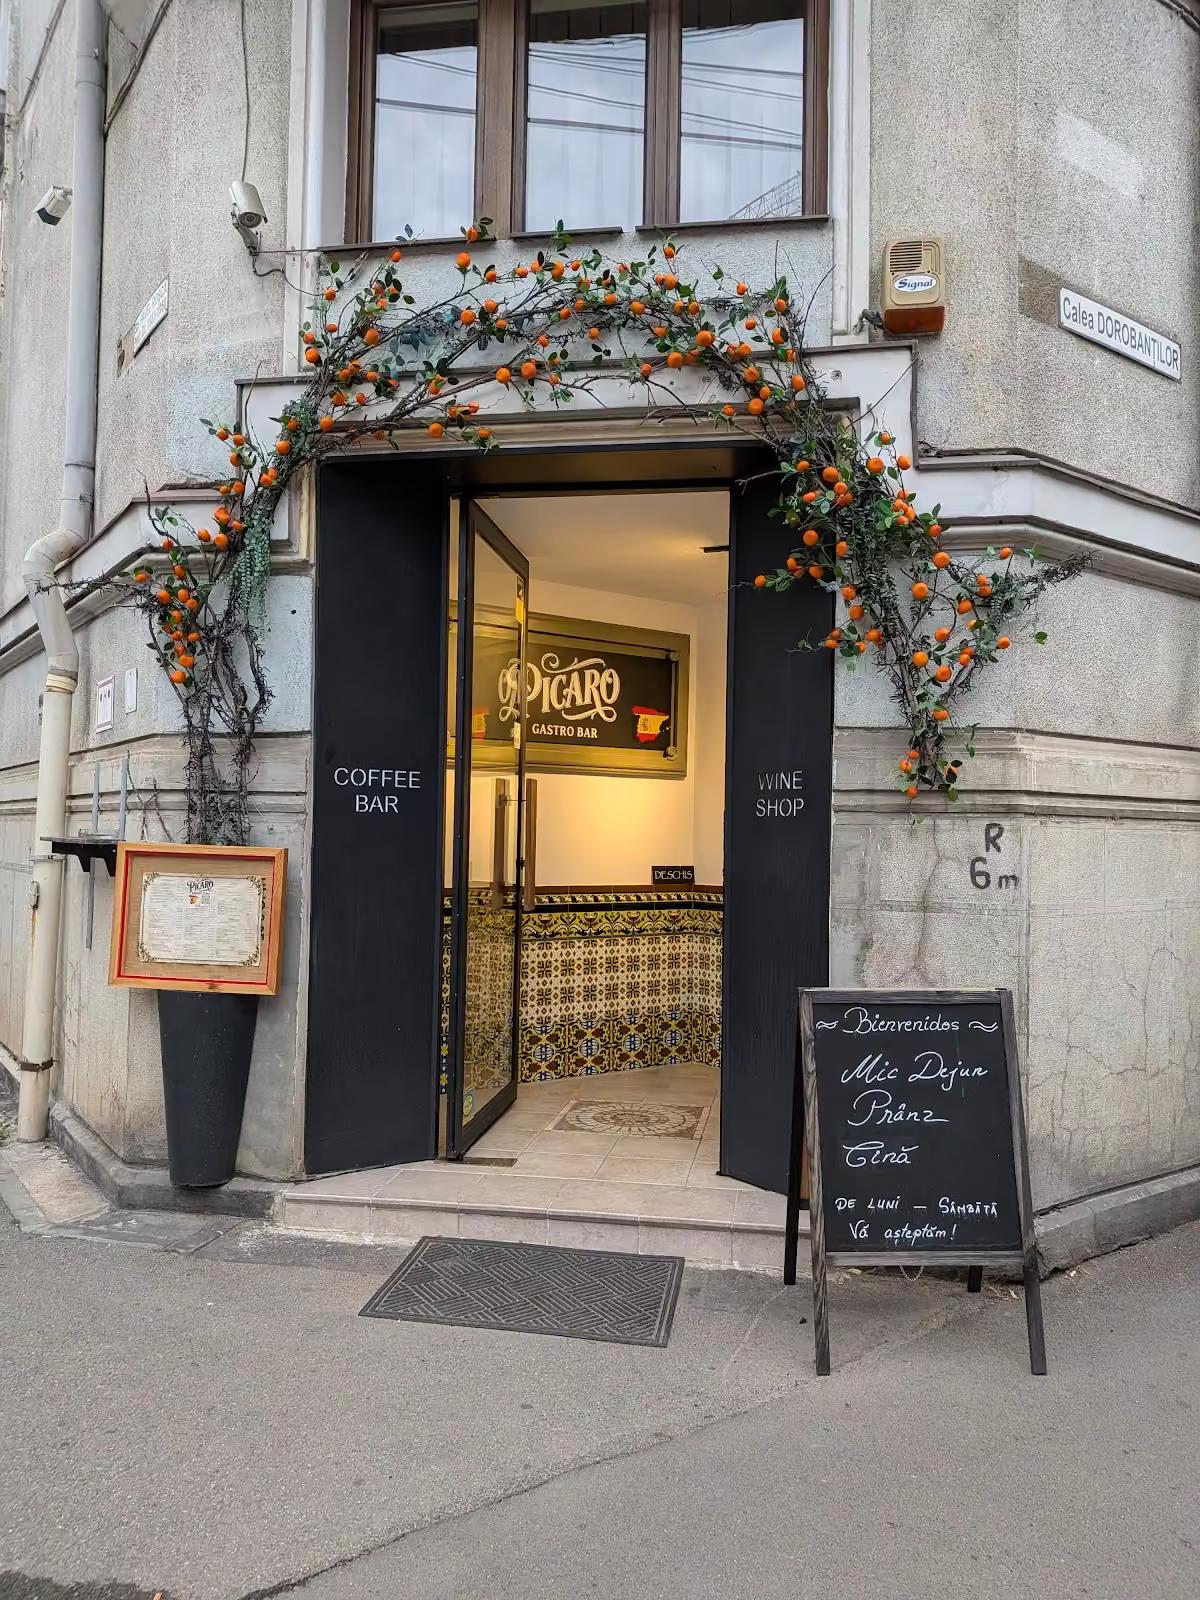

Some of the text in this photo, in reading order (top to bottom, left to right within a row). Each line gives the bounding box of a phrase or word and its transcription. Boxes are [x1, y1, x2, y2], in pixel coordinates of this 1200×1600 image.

[898, 278, 933, 291] Signal
[1063, 297, 1094, 330] Calea
[532, 723, 575, 737] GASTRO
[577, 726, 598, 738] BAR
[334, 767, 421, 788] COFFEE
[758, 770, 803, 790] WINE
[355, 794, 399, 813] BAR
[756, 798, 804, 817] SHOP
[985, 822, 1004, 853] R
[654, 870, 693, 880] DESCHIS
[842, 1006, 960, 1034] Bienvenidos
[841, 1051, 989, 1091] Mic Dejun
[847, 1089, 949, 1126] Prânz
[835, 1197, 857, 1211] DE
